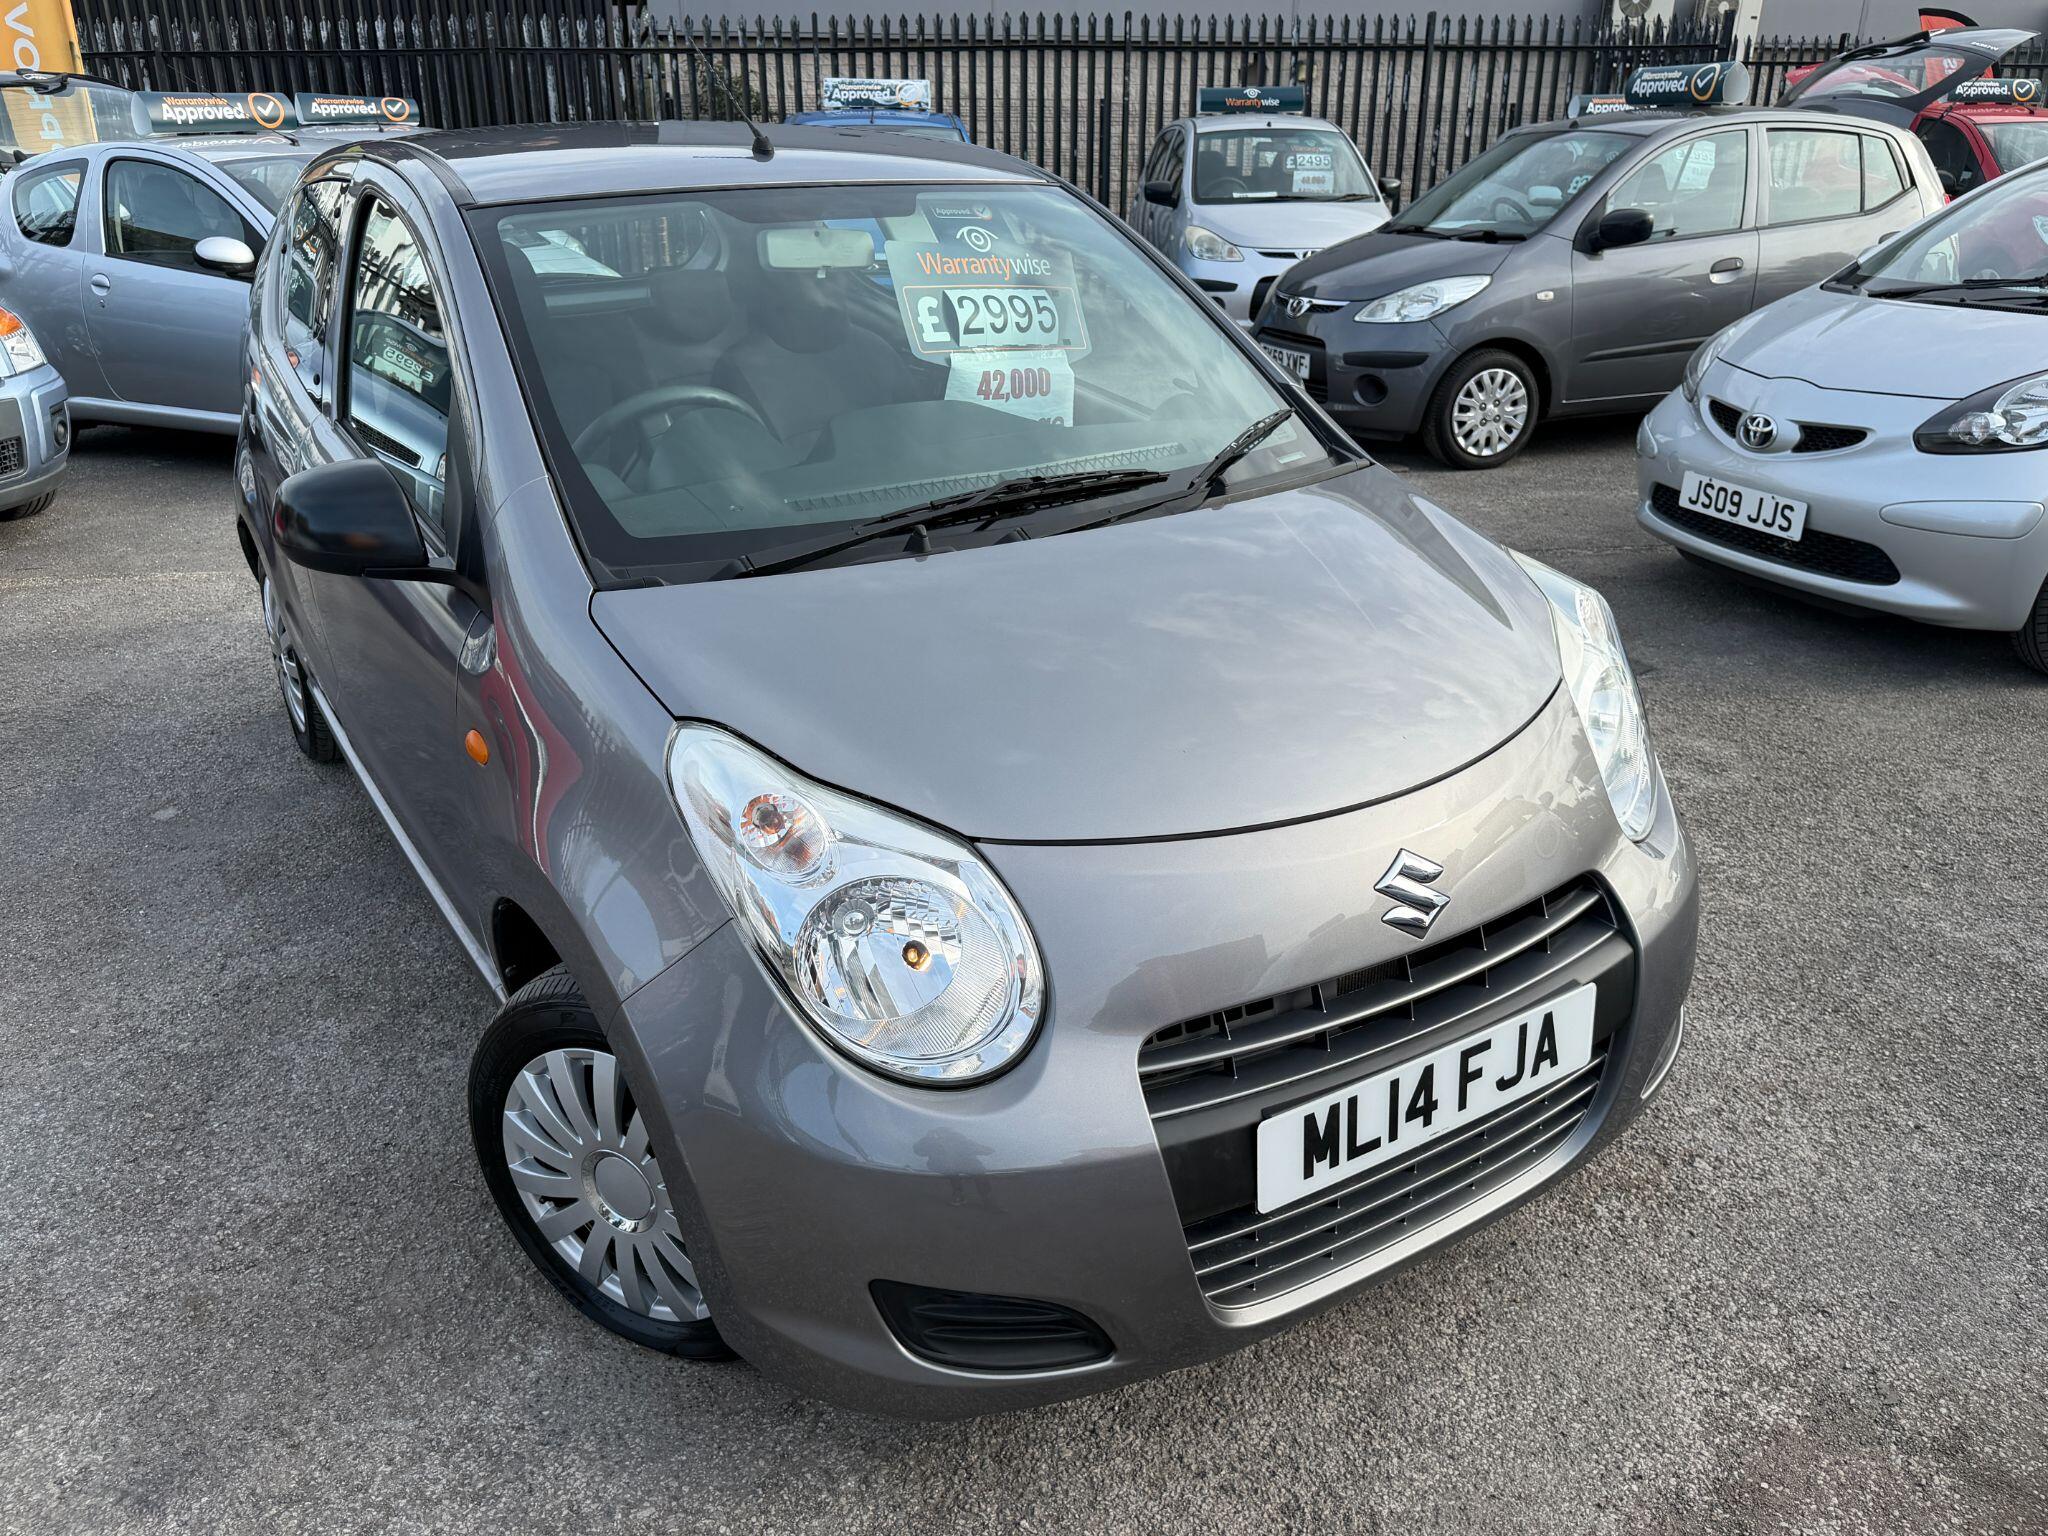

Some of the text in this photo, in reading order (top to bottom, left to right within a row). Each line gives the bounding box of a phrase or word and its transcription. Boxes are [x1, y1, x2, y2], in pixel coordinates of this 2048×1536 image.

[1632, 76, 1689, 97] Approved.
[162, 102, 250, 124] Approved.
[311, 102, 381, 116] Approved.
[314, 97, 366, 106] Warrantywise
[1225, 97, 1280, 108] Warrantywise
[916, 251, 1052, 281] Warrantywise
[917, 294, 1057, 343] £2995
[976, 367, 1052, 402] 42,000
[1688, 479, 1795, 533] JS09 JJS
[1303, 1011, 1559, 1181] ML14 FJA
